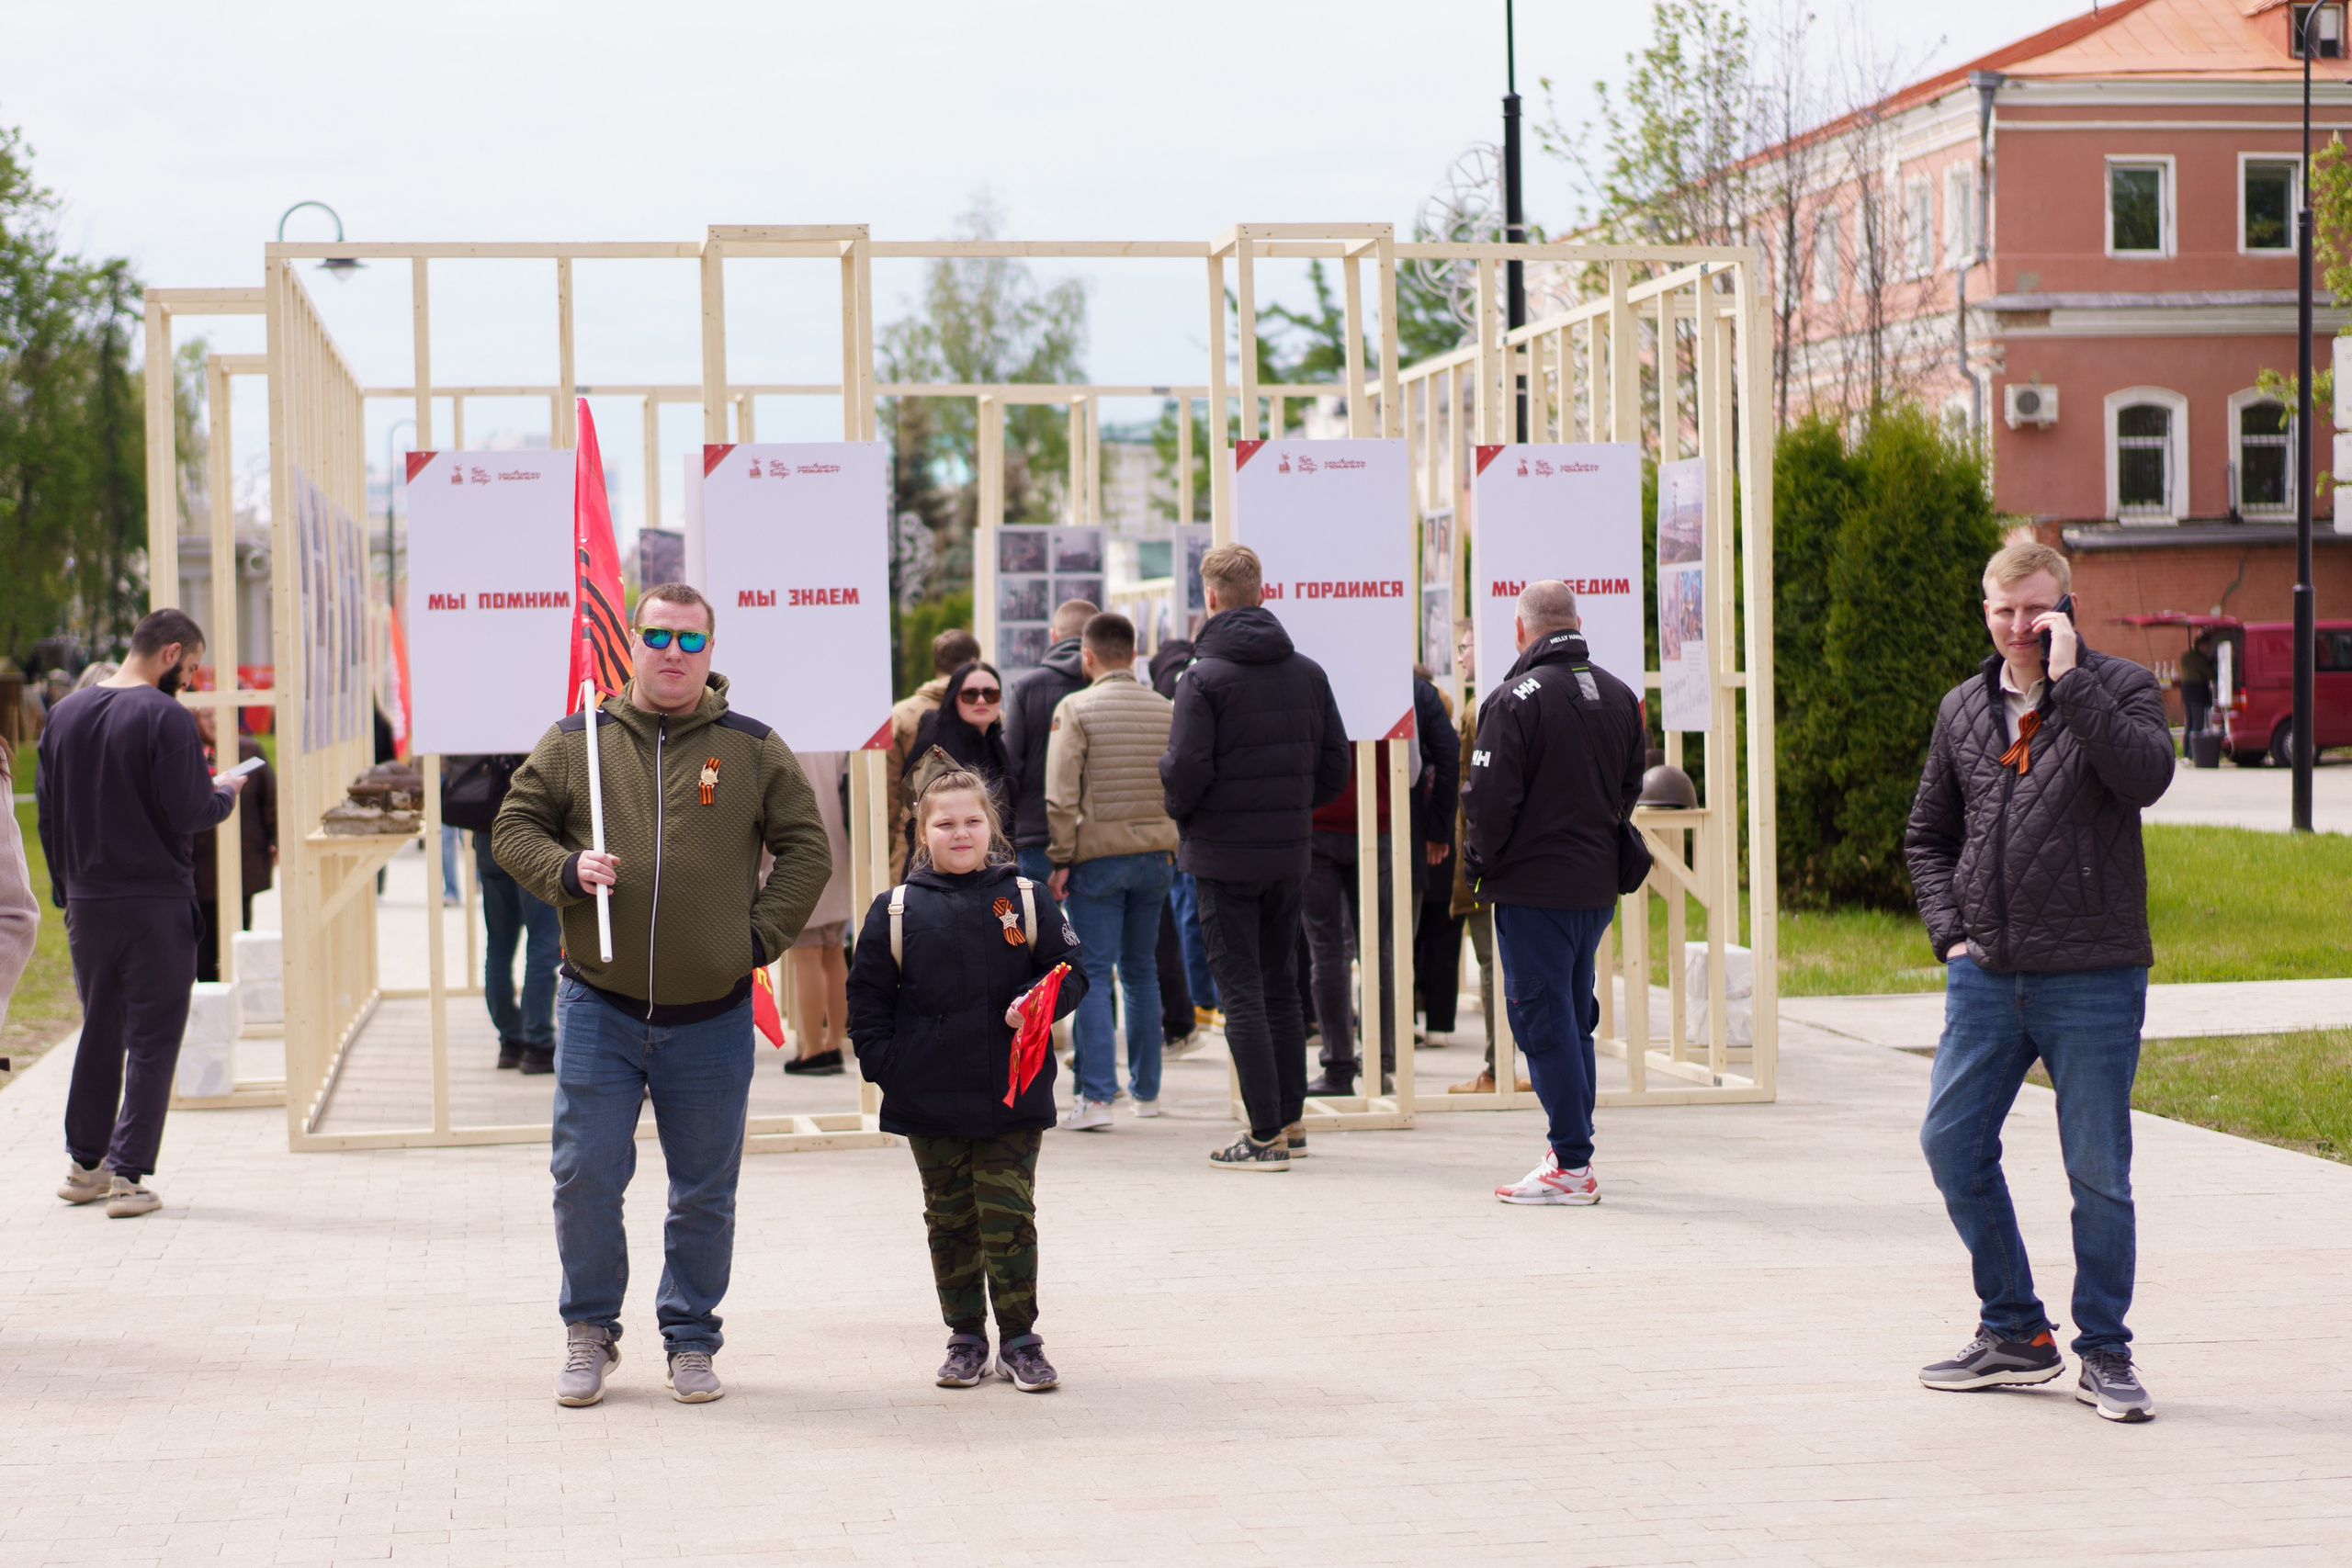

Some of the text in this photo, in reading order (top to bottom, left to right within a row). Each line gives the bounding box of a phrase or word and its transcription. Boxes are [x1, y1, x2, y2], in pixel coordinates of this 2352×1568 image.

[738, 588, 860, 607] МЫ ЗНАЕМ
[1265, 581, 1404, 600] Ы ГОРДИМСЯ
[1492, 581, 1526, 597] МЫ
[428, 592, 571, 610] МЫ ПОМНИМ
[1550, 635, 1568, 645] HELLY
[1512, 677, 1542, 701] HH
